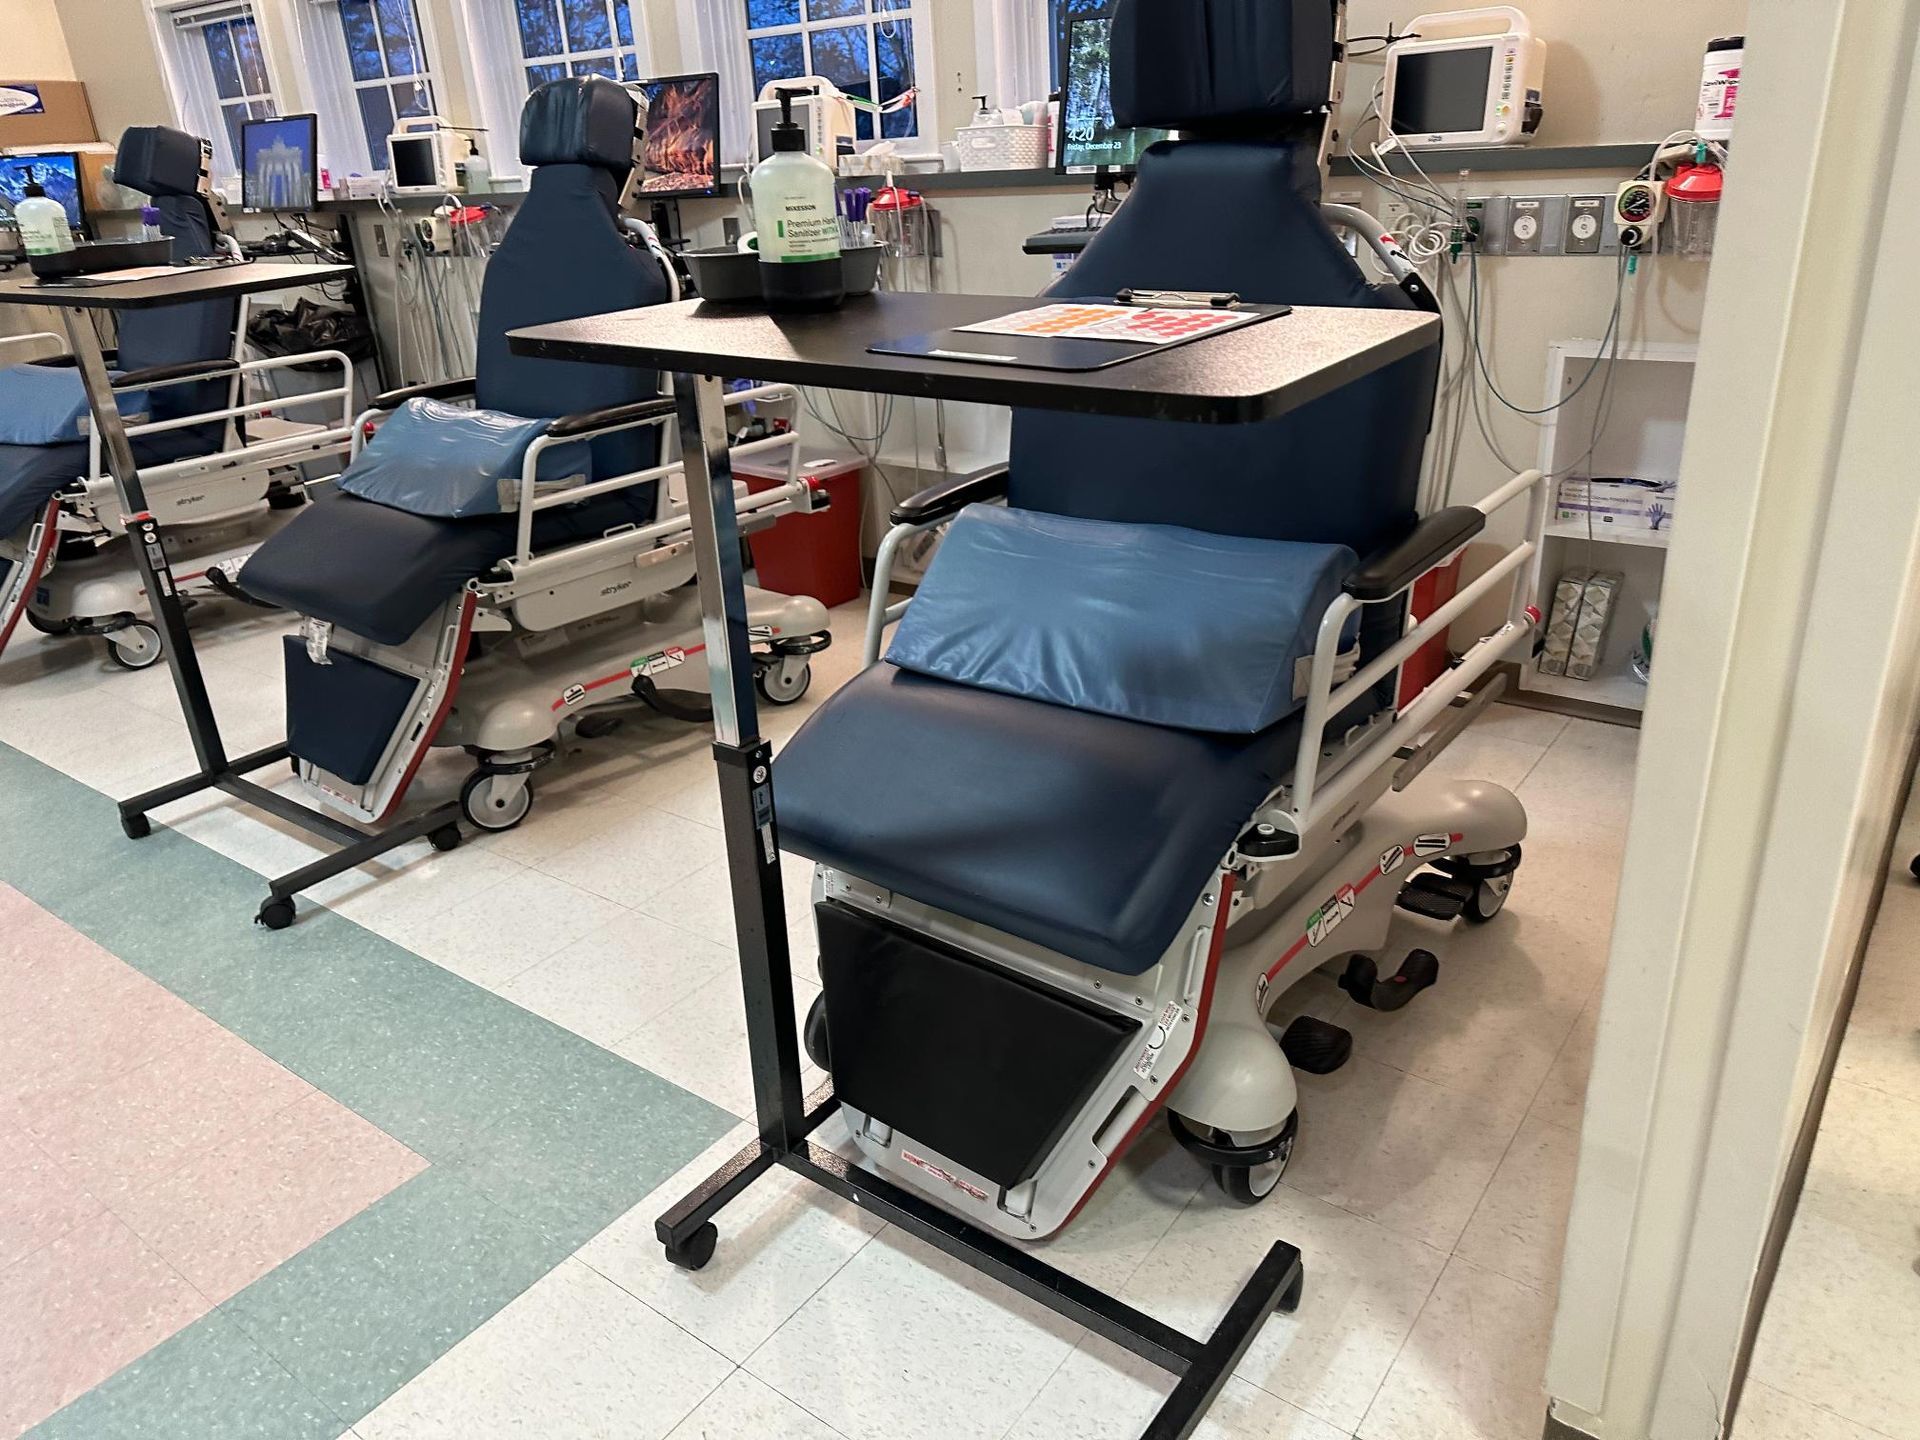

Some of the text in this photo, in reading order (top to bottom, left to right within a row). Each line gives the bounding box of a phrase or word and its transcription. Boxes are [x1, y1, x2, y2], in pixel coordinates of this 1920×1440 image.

[1086, 142, 1113, 150] December
[1113, 141, 1121, 149] 23
[787, 218, 821, 228] Premium
[788, 229, 820, 237] Sanitizer
